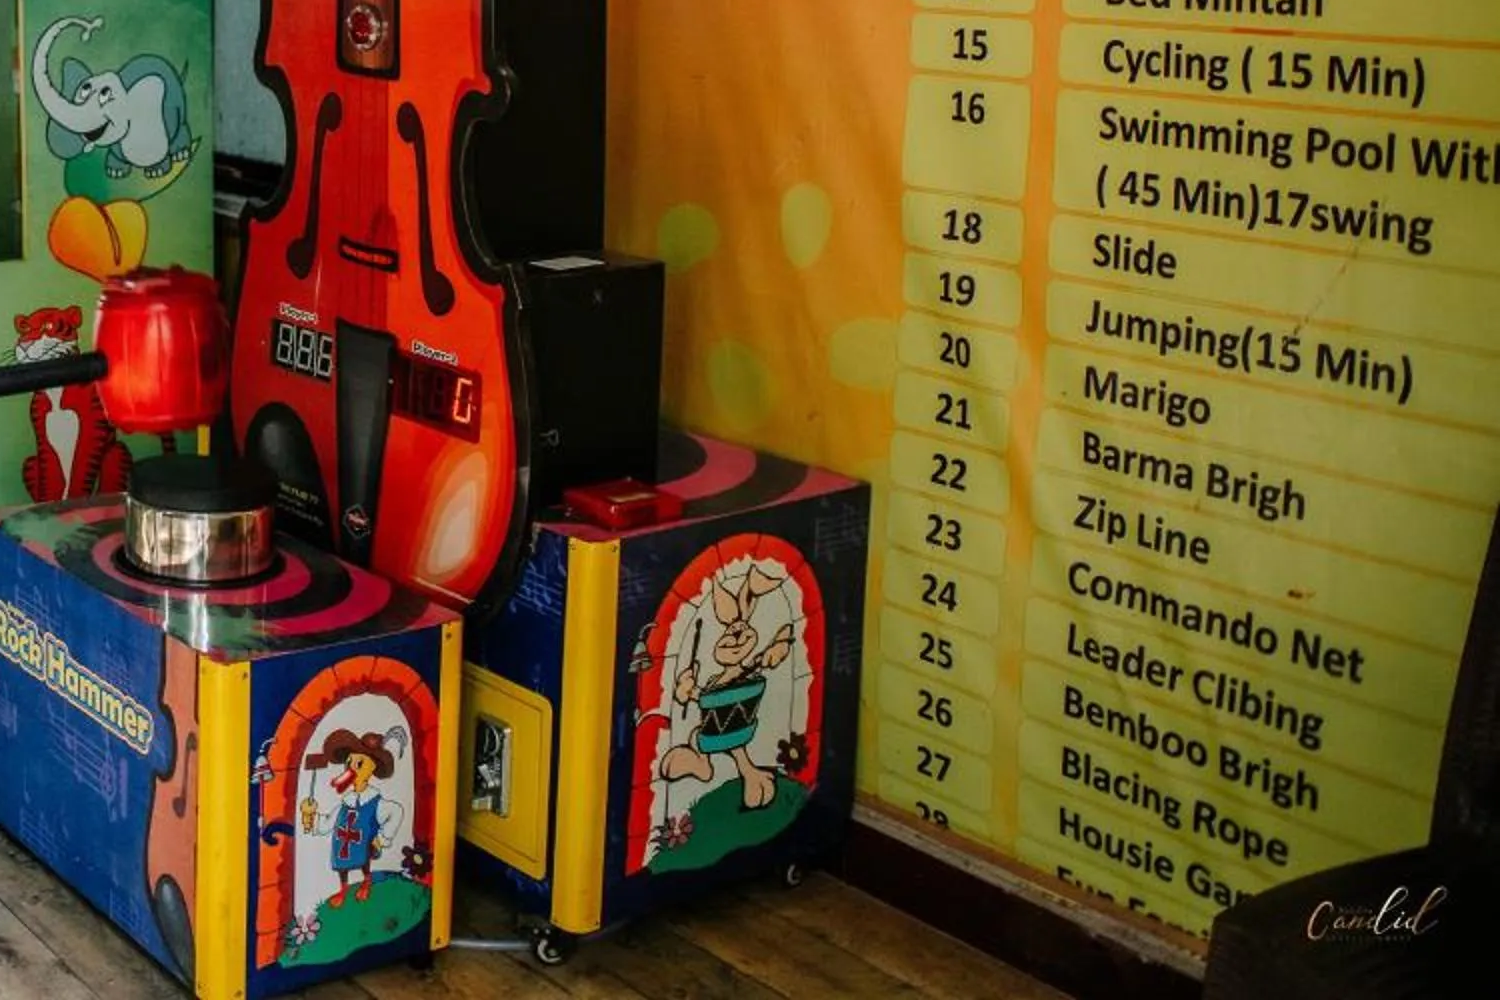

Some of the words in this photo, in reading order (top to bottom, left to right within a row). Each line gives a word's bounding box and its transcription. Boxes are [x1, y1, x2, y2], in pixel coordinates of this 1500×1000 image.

[953, 30, 988, 61] 15
[1103, 40, 1229, 90] Cycling
[1266, 54, 1312, 88] 15
[951, 92, 985, 124] 16
[1100, 107, 1293, 168] Swimming
[1306, 127, 1395, 174] Pool
[1411, 136, 1500, 184] Wit
[1119, 172, 1161, 207] 45
[943, 210, 983, 244] 18
[1093, 234, 1177, 279] Slide
[939, 272, 975, 305] 19
[940, 333, 971, 368] 20
[935, 394, 972, 430] 21
[1084, 366, 1211, 428] Marigo
[931, 454, 967, 491] 22
[1083, 431, 1193, 491] Barma
[1207, 464, 1306, 521] Brigh
[925, 515, 962, 552] 23
[1074, 495, 1126, 543] Zip
[1138, 513, 1211, 564] Line
[921, 574, 958, 613] 24
[1068, 563, 1278, 657] Commando
[1291, 630, 1365, 685] Net
[919, 633, 954, 670] 25
[47, 644, 149, 742] Hammer
[1067, 623, 1183, 692] Leader
[1193, 670, 1324, 751] Clibing
[917, 691, 953, 728] 26
[917, 747, 952, 783] 27
[1064, 686, 1207, 768] Bemboo
[1220, 745, 1319, 813] Brigh
[1061, 747, 1181, 829] Blacing
[1194, 794, 1288, 867] Rope
[1059, 808, 1174, 883] Housie
